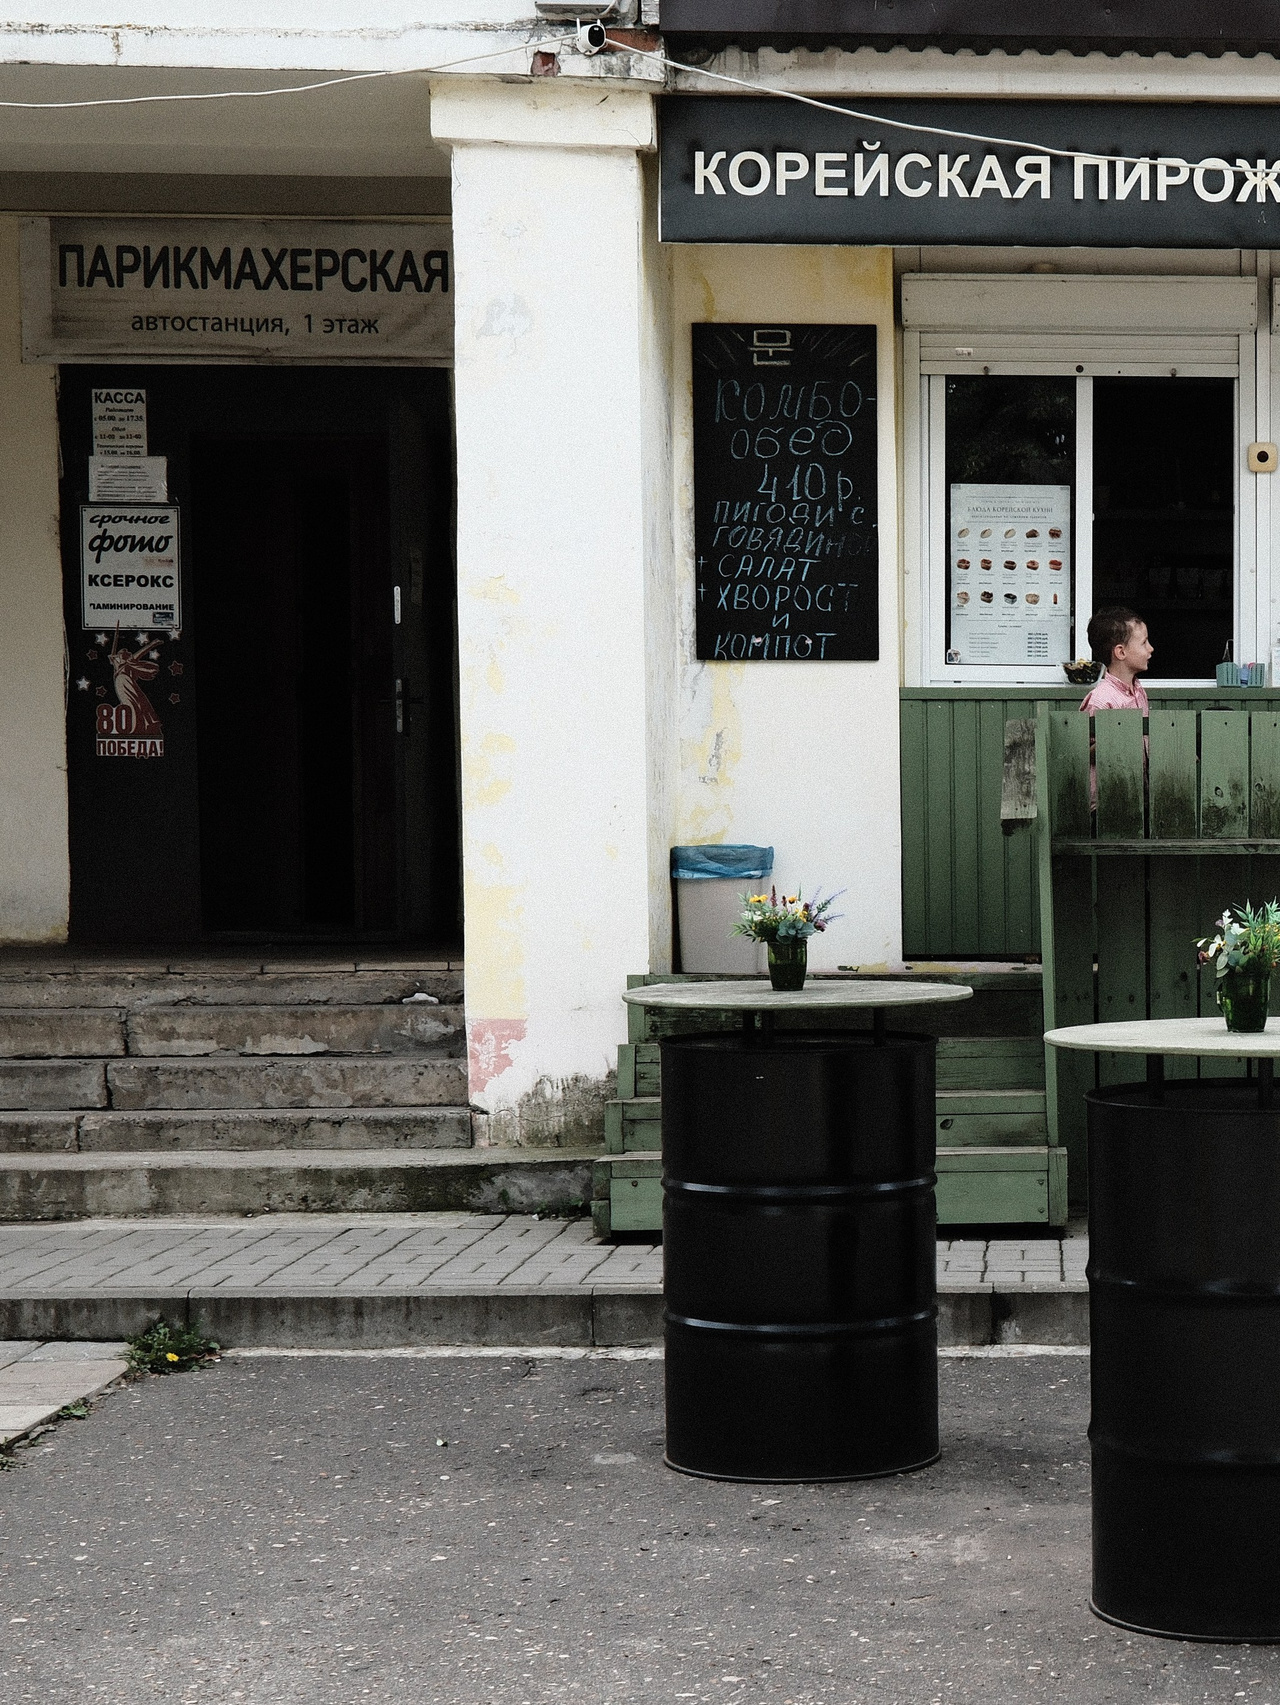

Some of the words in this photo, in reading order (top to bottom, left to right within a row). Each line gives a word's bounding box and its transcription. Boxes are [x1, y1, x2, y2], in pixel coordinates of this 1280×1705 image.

[693, 141, 1051, 199] КОРЕЙСКАЯ
[58, 244, 449, 293] ПАРИКМАХЕРСКАЯ
[131, 316, 290, 337] автостанция,
[304, 315, 313, 333] 1
[322, 316, 379, 335] этаж
[94, 391, 145, 404] КАССА
[757, 463, 826, 502] 410
[89, 515, 170, 528] срочное
[88, 528, 173, 563] фото
[88, 574, 174, 587] КСЕРОКС
[718, 554, 822, 582] САЛАТ
[717, 582, 859, 612] ХВОРОСТ
[97, 704, 133, 735] 80
[97, 740, 164, 758] ПОБЕДА!
